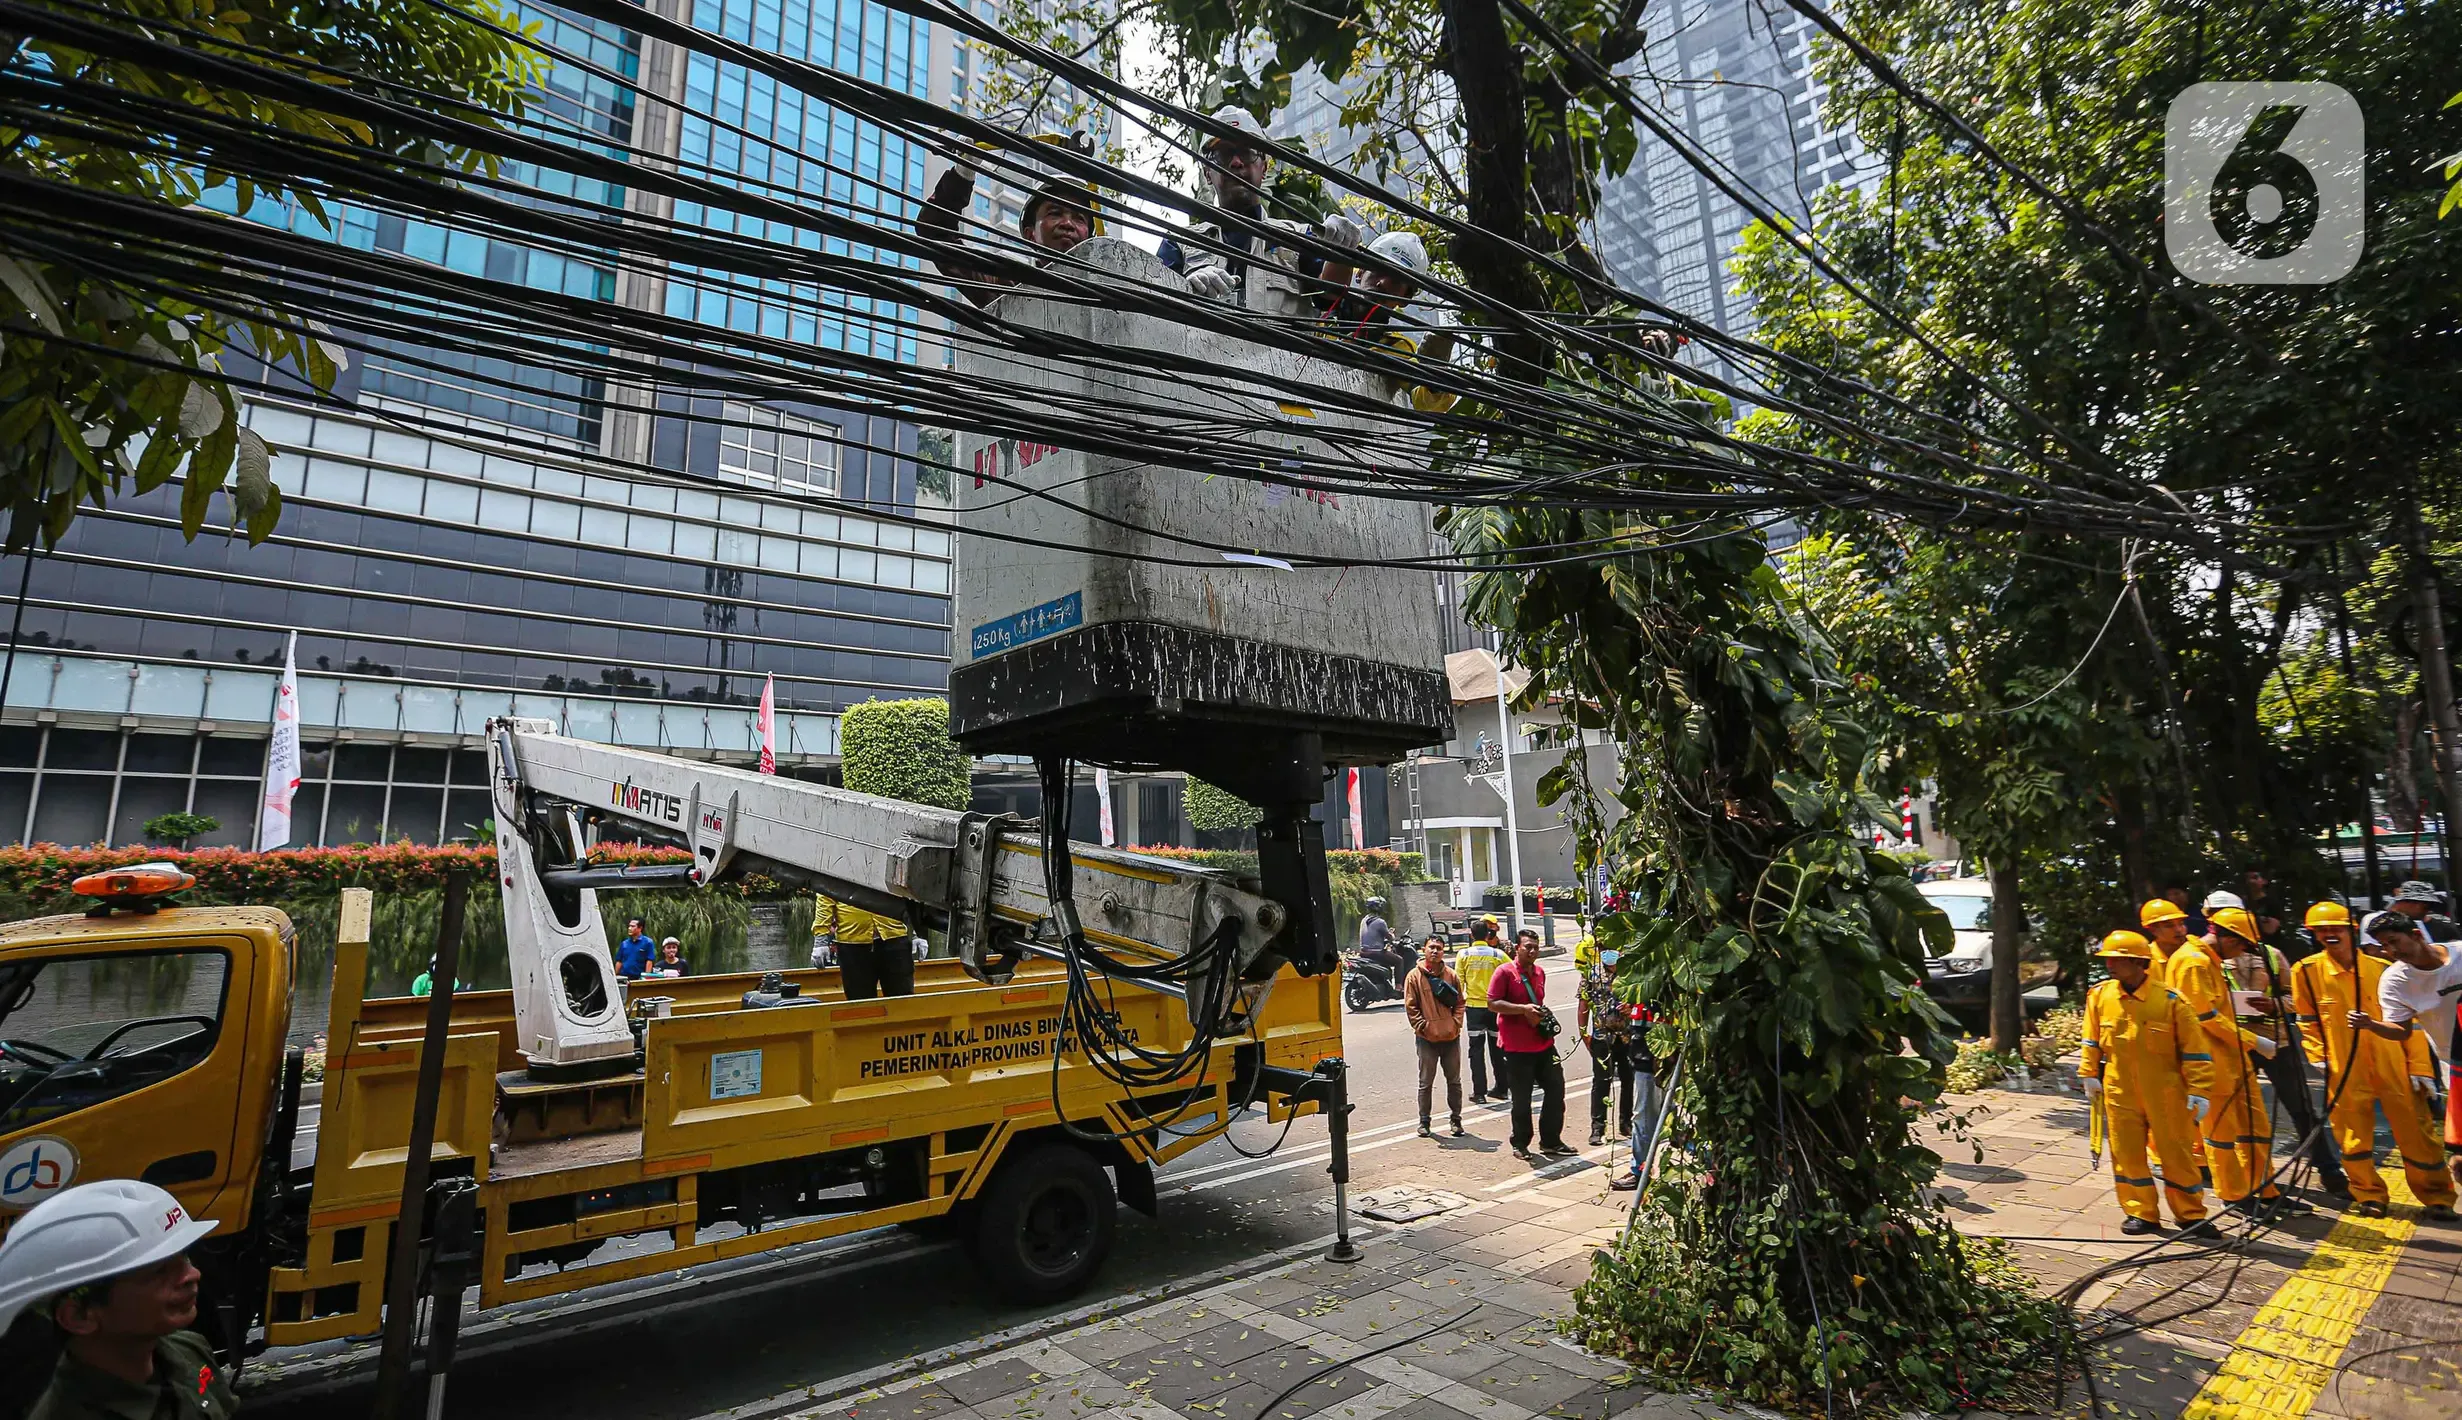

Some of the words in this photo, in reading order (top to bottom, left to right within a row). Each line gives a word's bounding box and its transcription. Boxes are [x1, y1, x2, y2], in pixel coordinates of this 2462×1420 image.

[884, 1032, 926, 1054] UNIT
[984, 1020, 1032, 1042] DINAS
[1037, 1016, 1075, 1035] BINA
[860, 1050, 971, 1079] PEMERINTAH
[971, 1039, 1045, 1065] PROVINSI
